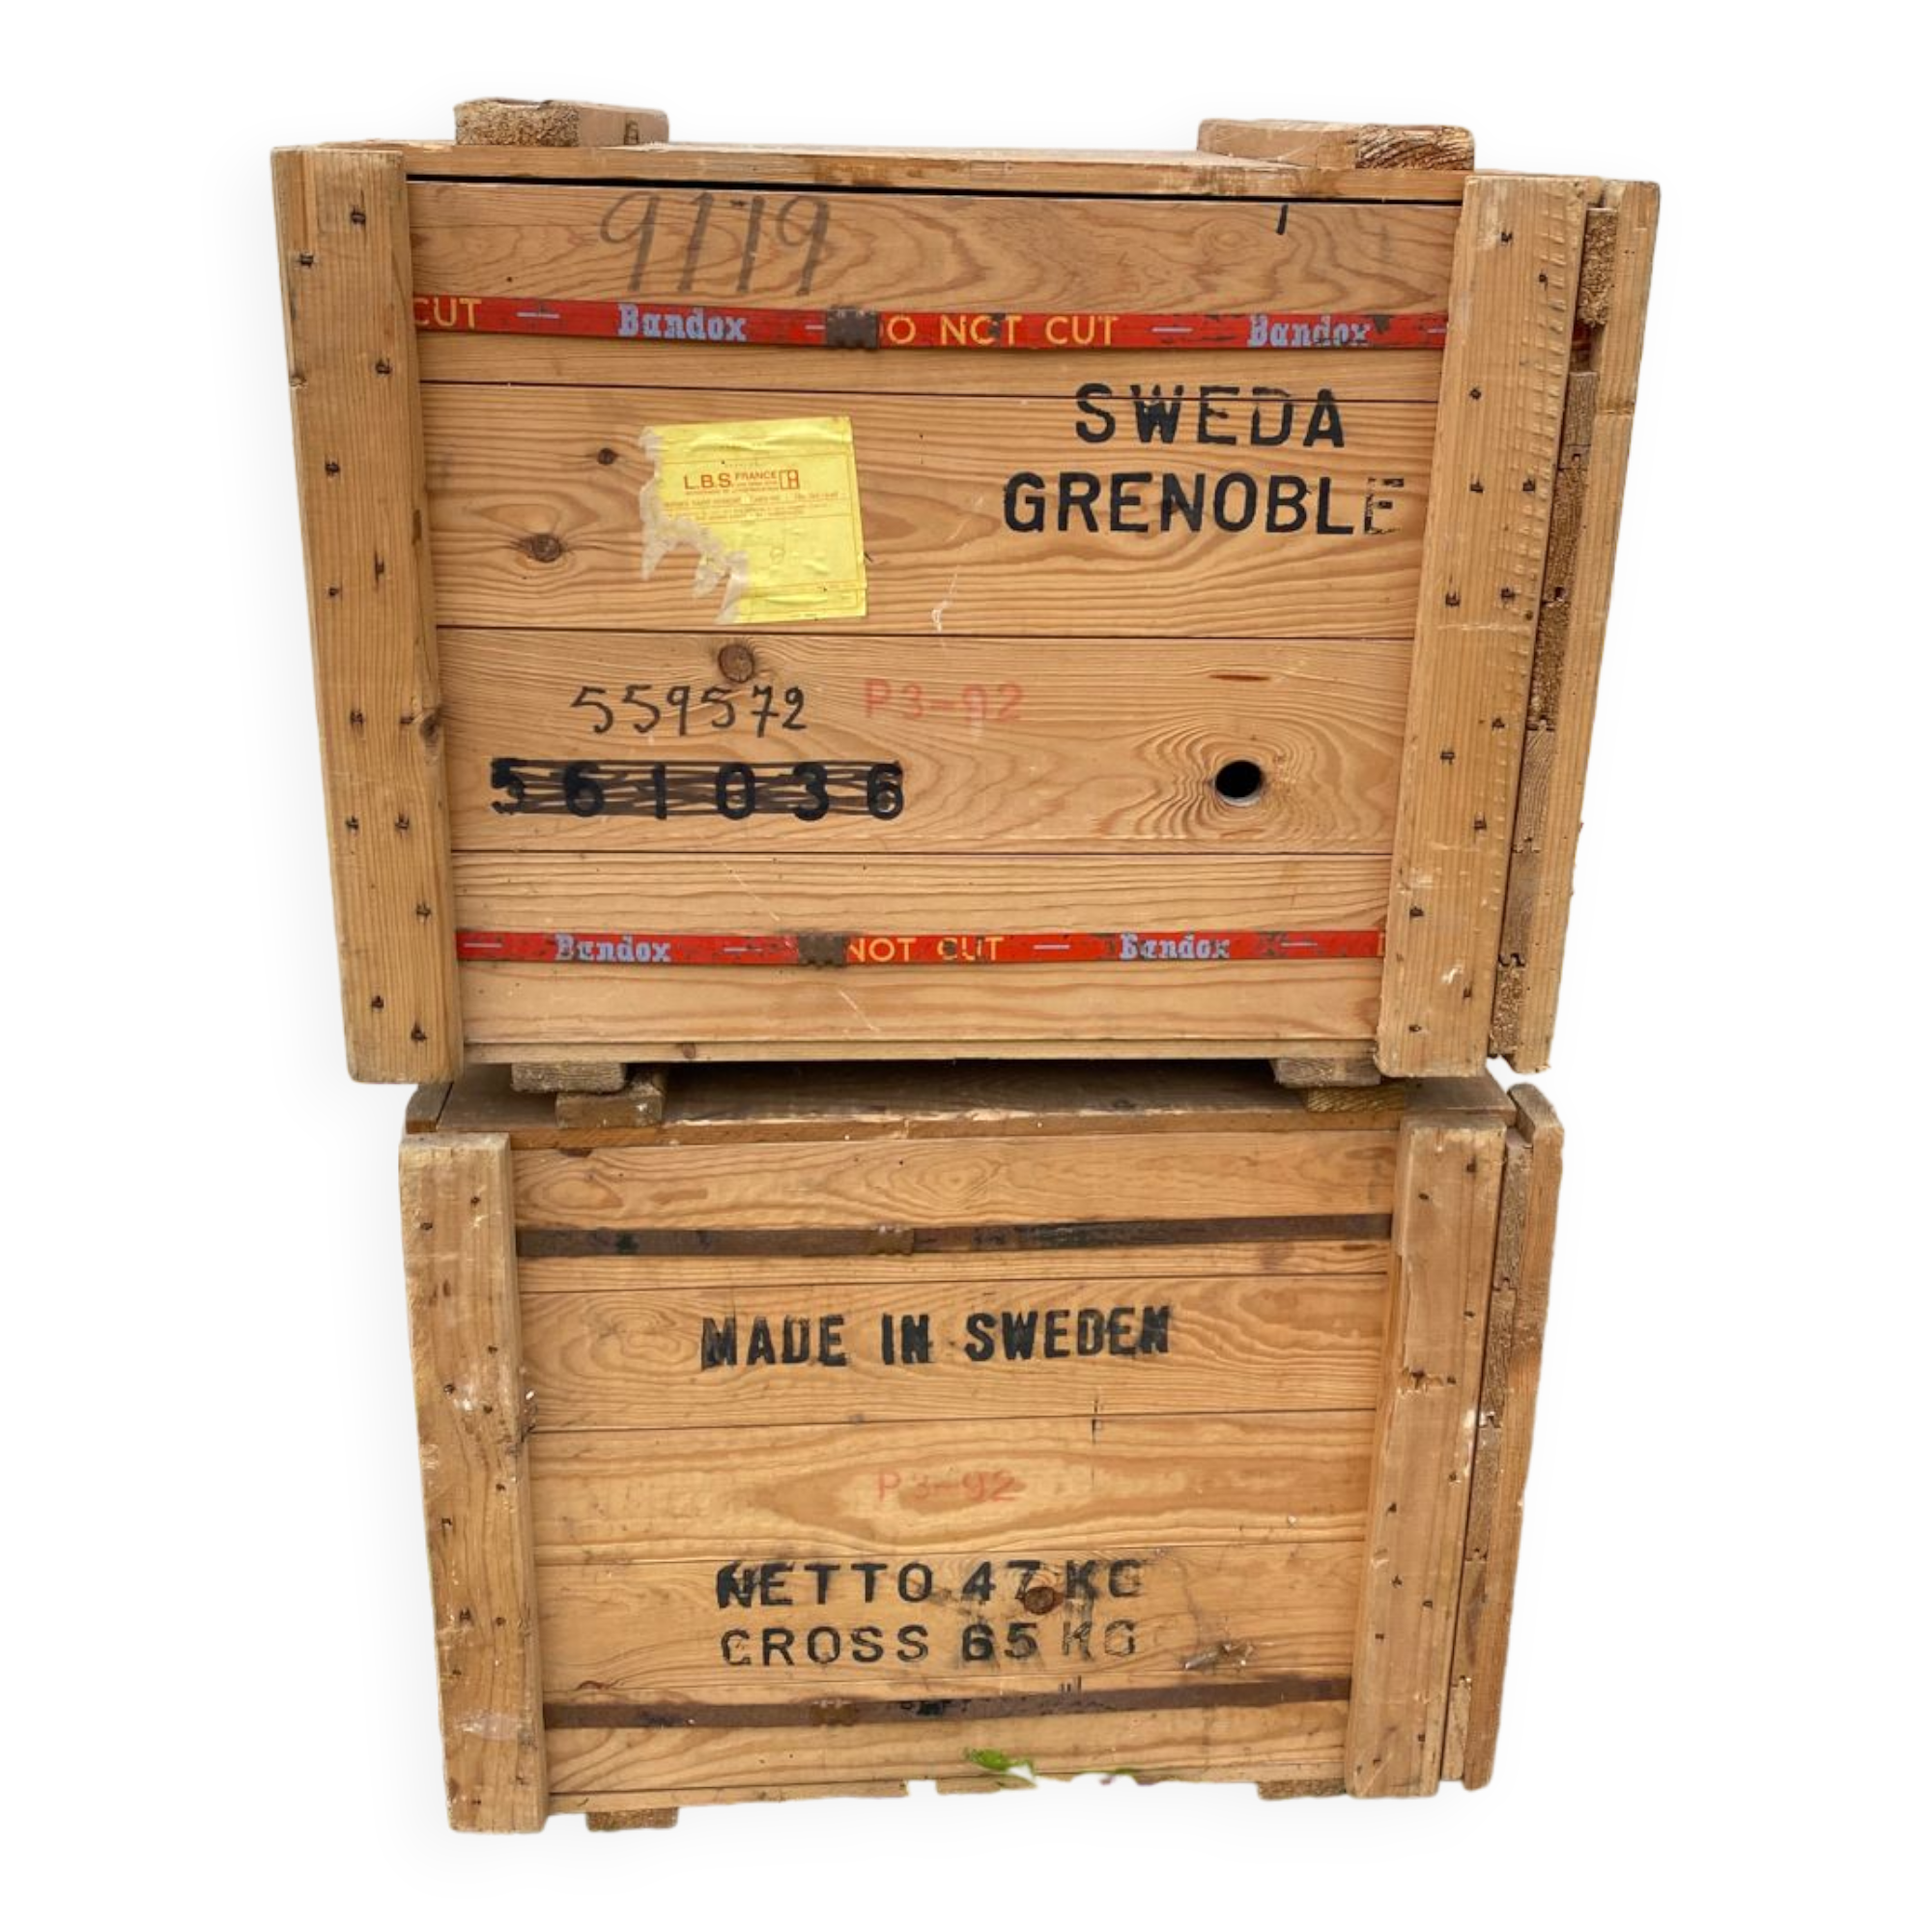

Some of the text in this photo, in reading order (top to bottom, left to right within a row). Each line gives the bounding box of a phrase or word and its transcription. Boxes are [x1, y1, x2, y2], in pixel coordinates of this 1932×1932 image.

[1045, 315, 1120, 346] CUT
[1075, 383, 1346, 448] SWEDA
[735, 471, 777, 480] FRANCE
[1003, 471, 1405, 536] GRENOBLE
[572, 683, 808, 738] 559572
[491, 757, 903, 820] 561036
[701, 1305, 1172, 1370] MADE IN SWEDEN
[716, 1561, 933, 1608] NETTO
[961, 1621, 1038, 1663] 65
